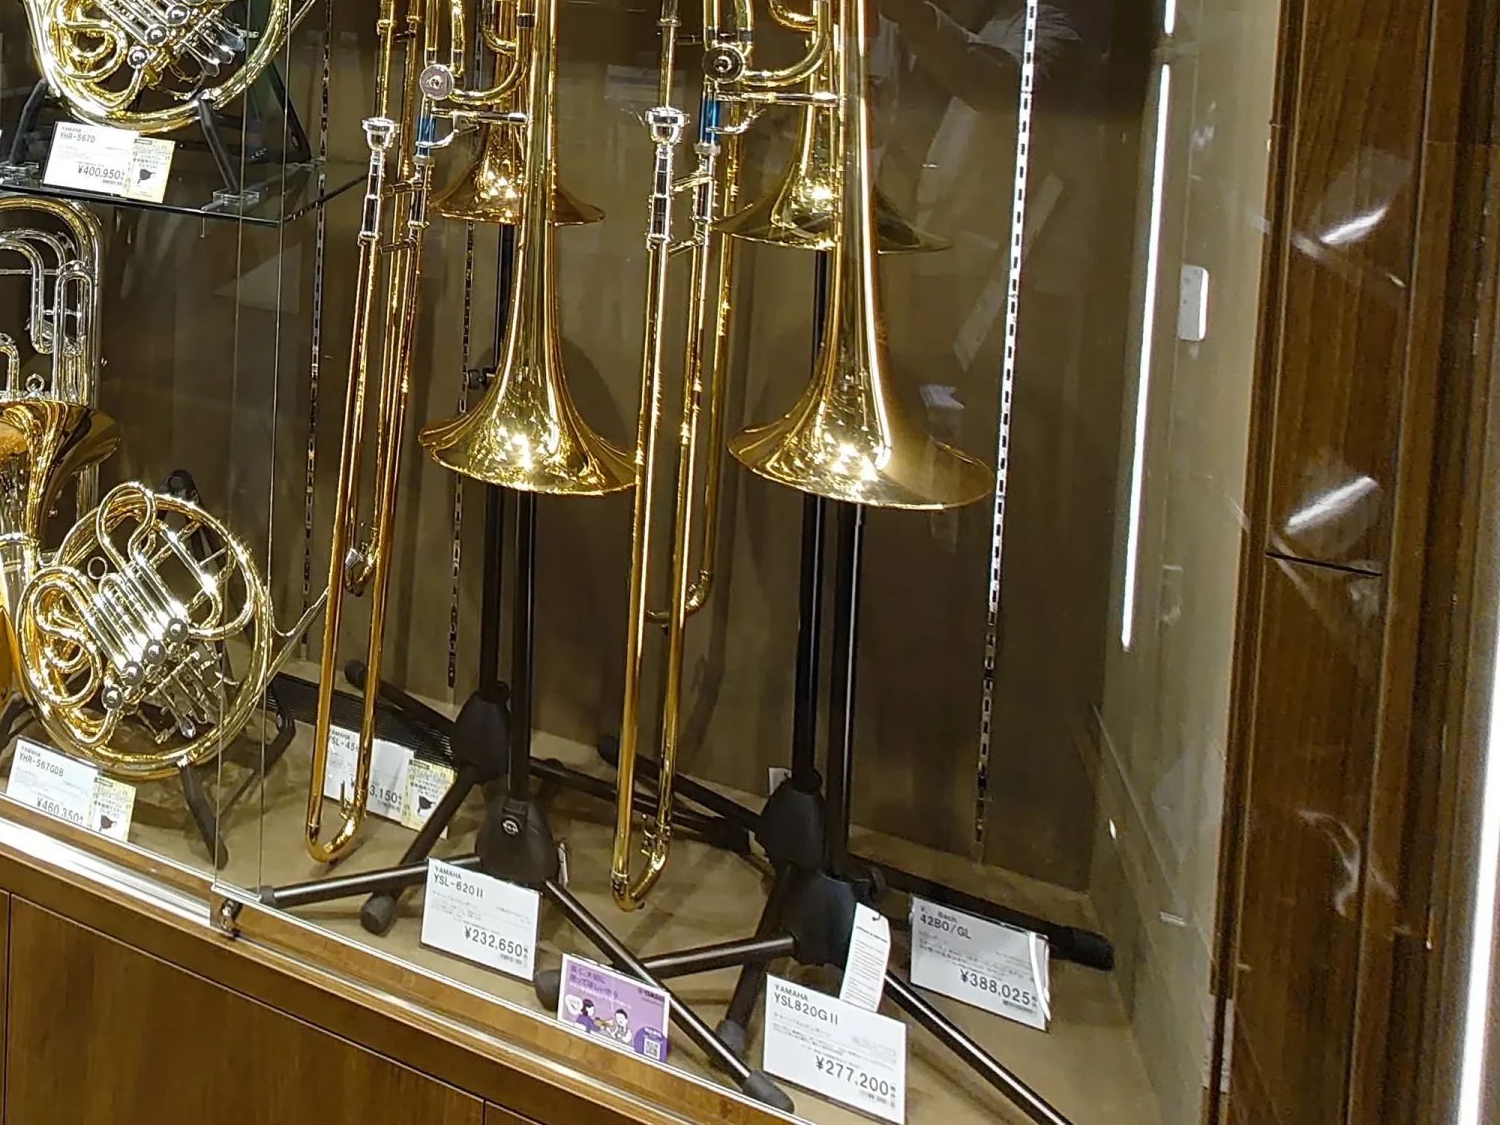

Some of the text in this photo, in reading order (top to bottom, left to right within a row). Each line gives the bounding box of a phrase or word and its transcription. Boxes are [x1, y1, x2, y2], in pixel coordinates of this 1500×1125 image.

[59, 132, 96, 144] YHR-567D
[21, 744, 42, 758] YAMAHA
[434, 866, 462, 880] YAMAHA
[937, 911, 958, 924] Bach
[774, 984, 809, 1002] YAMAHA
